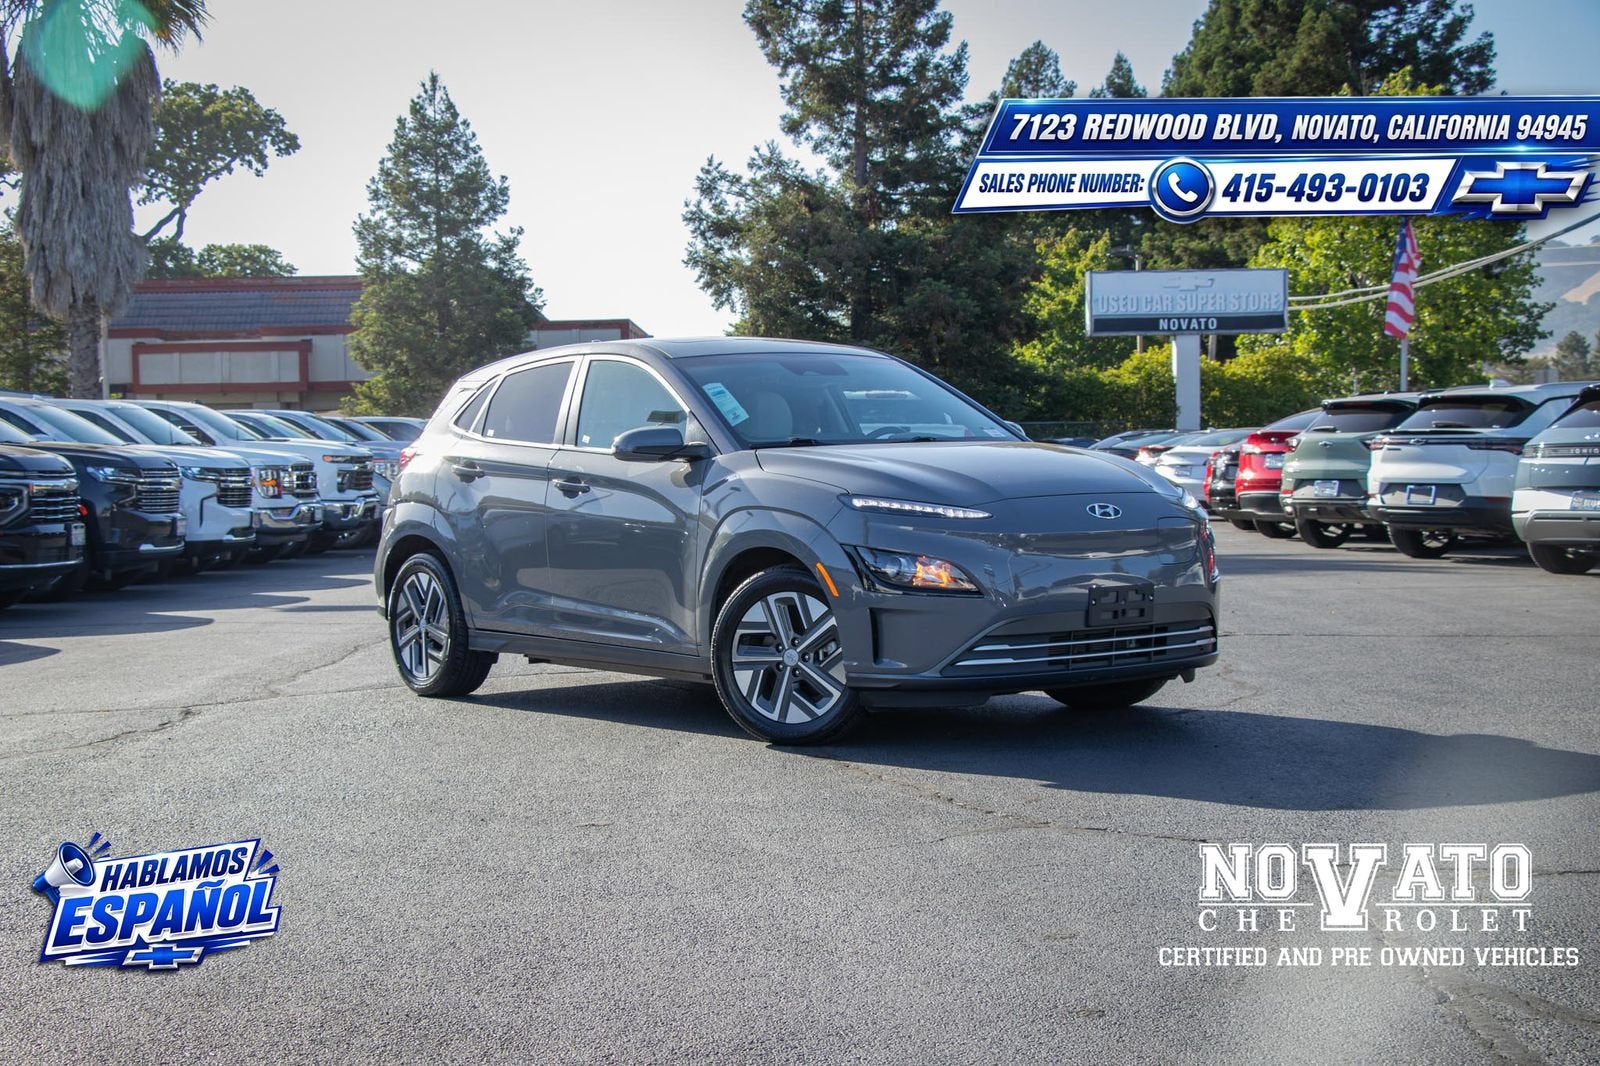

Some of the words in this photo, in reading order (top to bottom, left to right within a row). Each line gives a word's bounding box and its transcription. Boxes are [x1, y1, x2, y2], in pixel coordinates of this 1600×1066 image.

[1100, 295, 1139, 313] USED
[1143, 294, 1173, 312] CAR
[1176, 293, 1226, 312] SUPER
[1230, 292, 1281, 311] STORE
[1159, 317, 1218, 330] NOVATO
